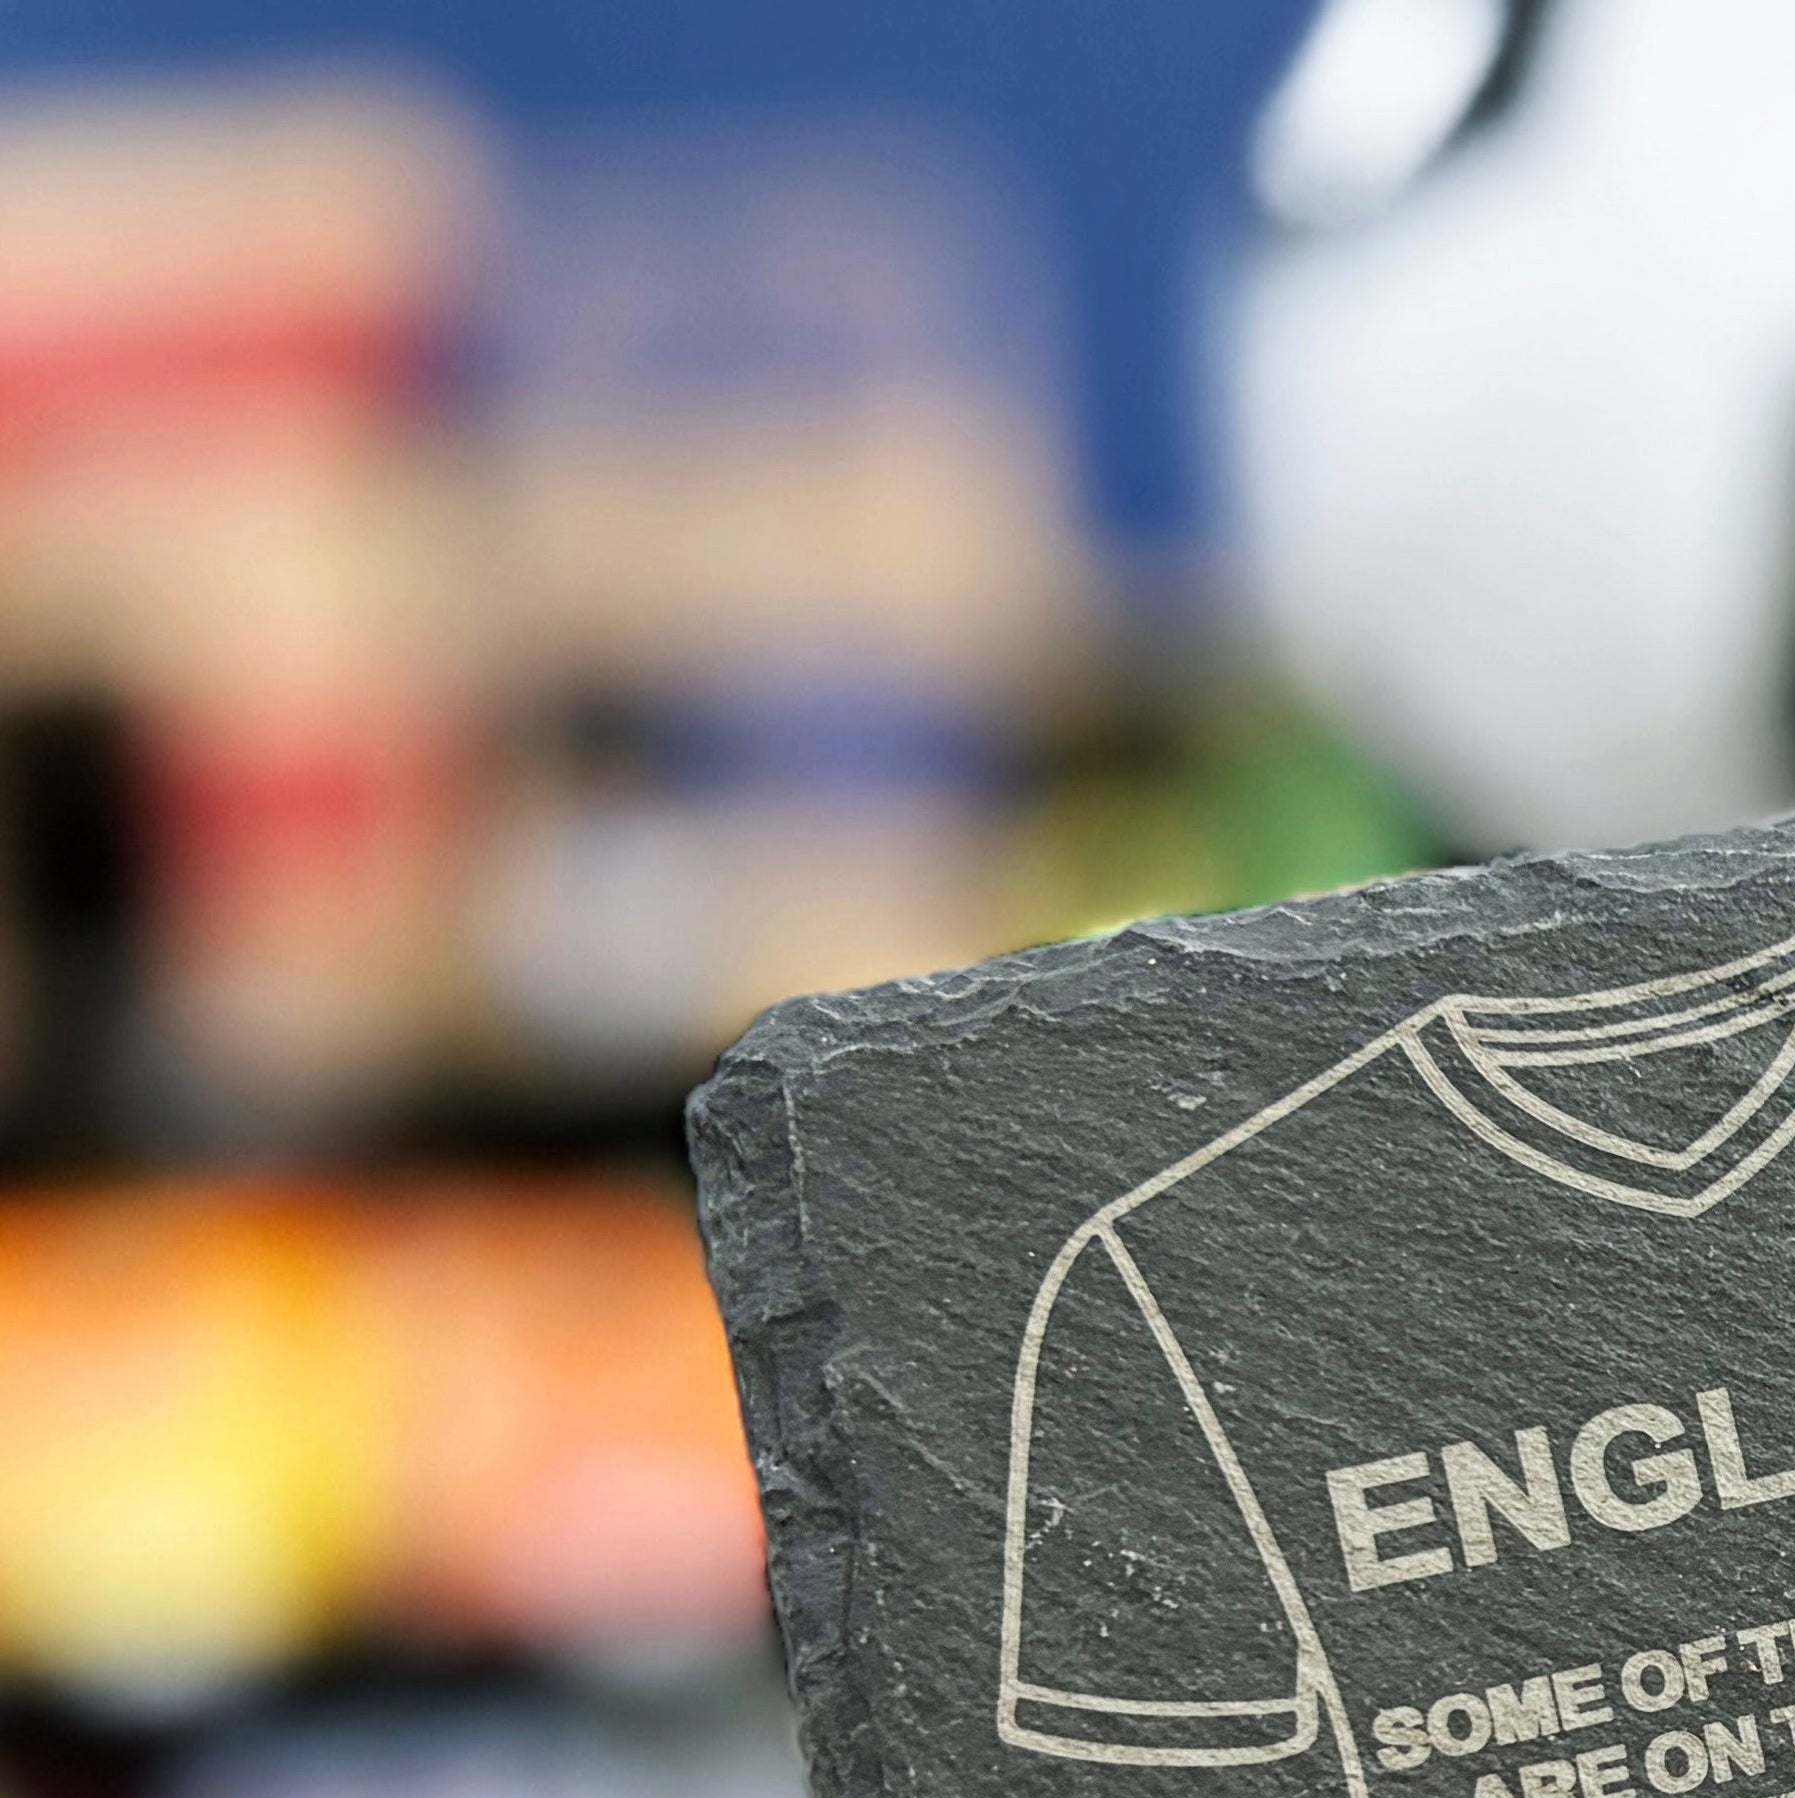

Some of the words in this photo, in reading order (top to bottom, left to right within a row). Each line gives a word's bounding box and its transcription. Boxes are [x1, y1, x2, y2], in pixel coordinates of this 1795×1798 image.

[1372, 1664, 1613, 1772] SOME
[1621, 1638, 1732, 1711] OF
[1644, 1719, 1767, 1796] ON
